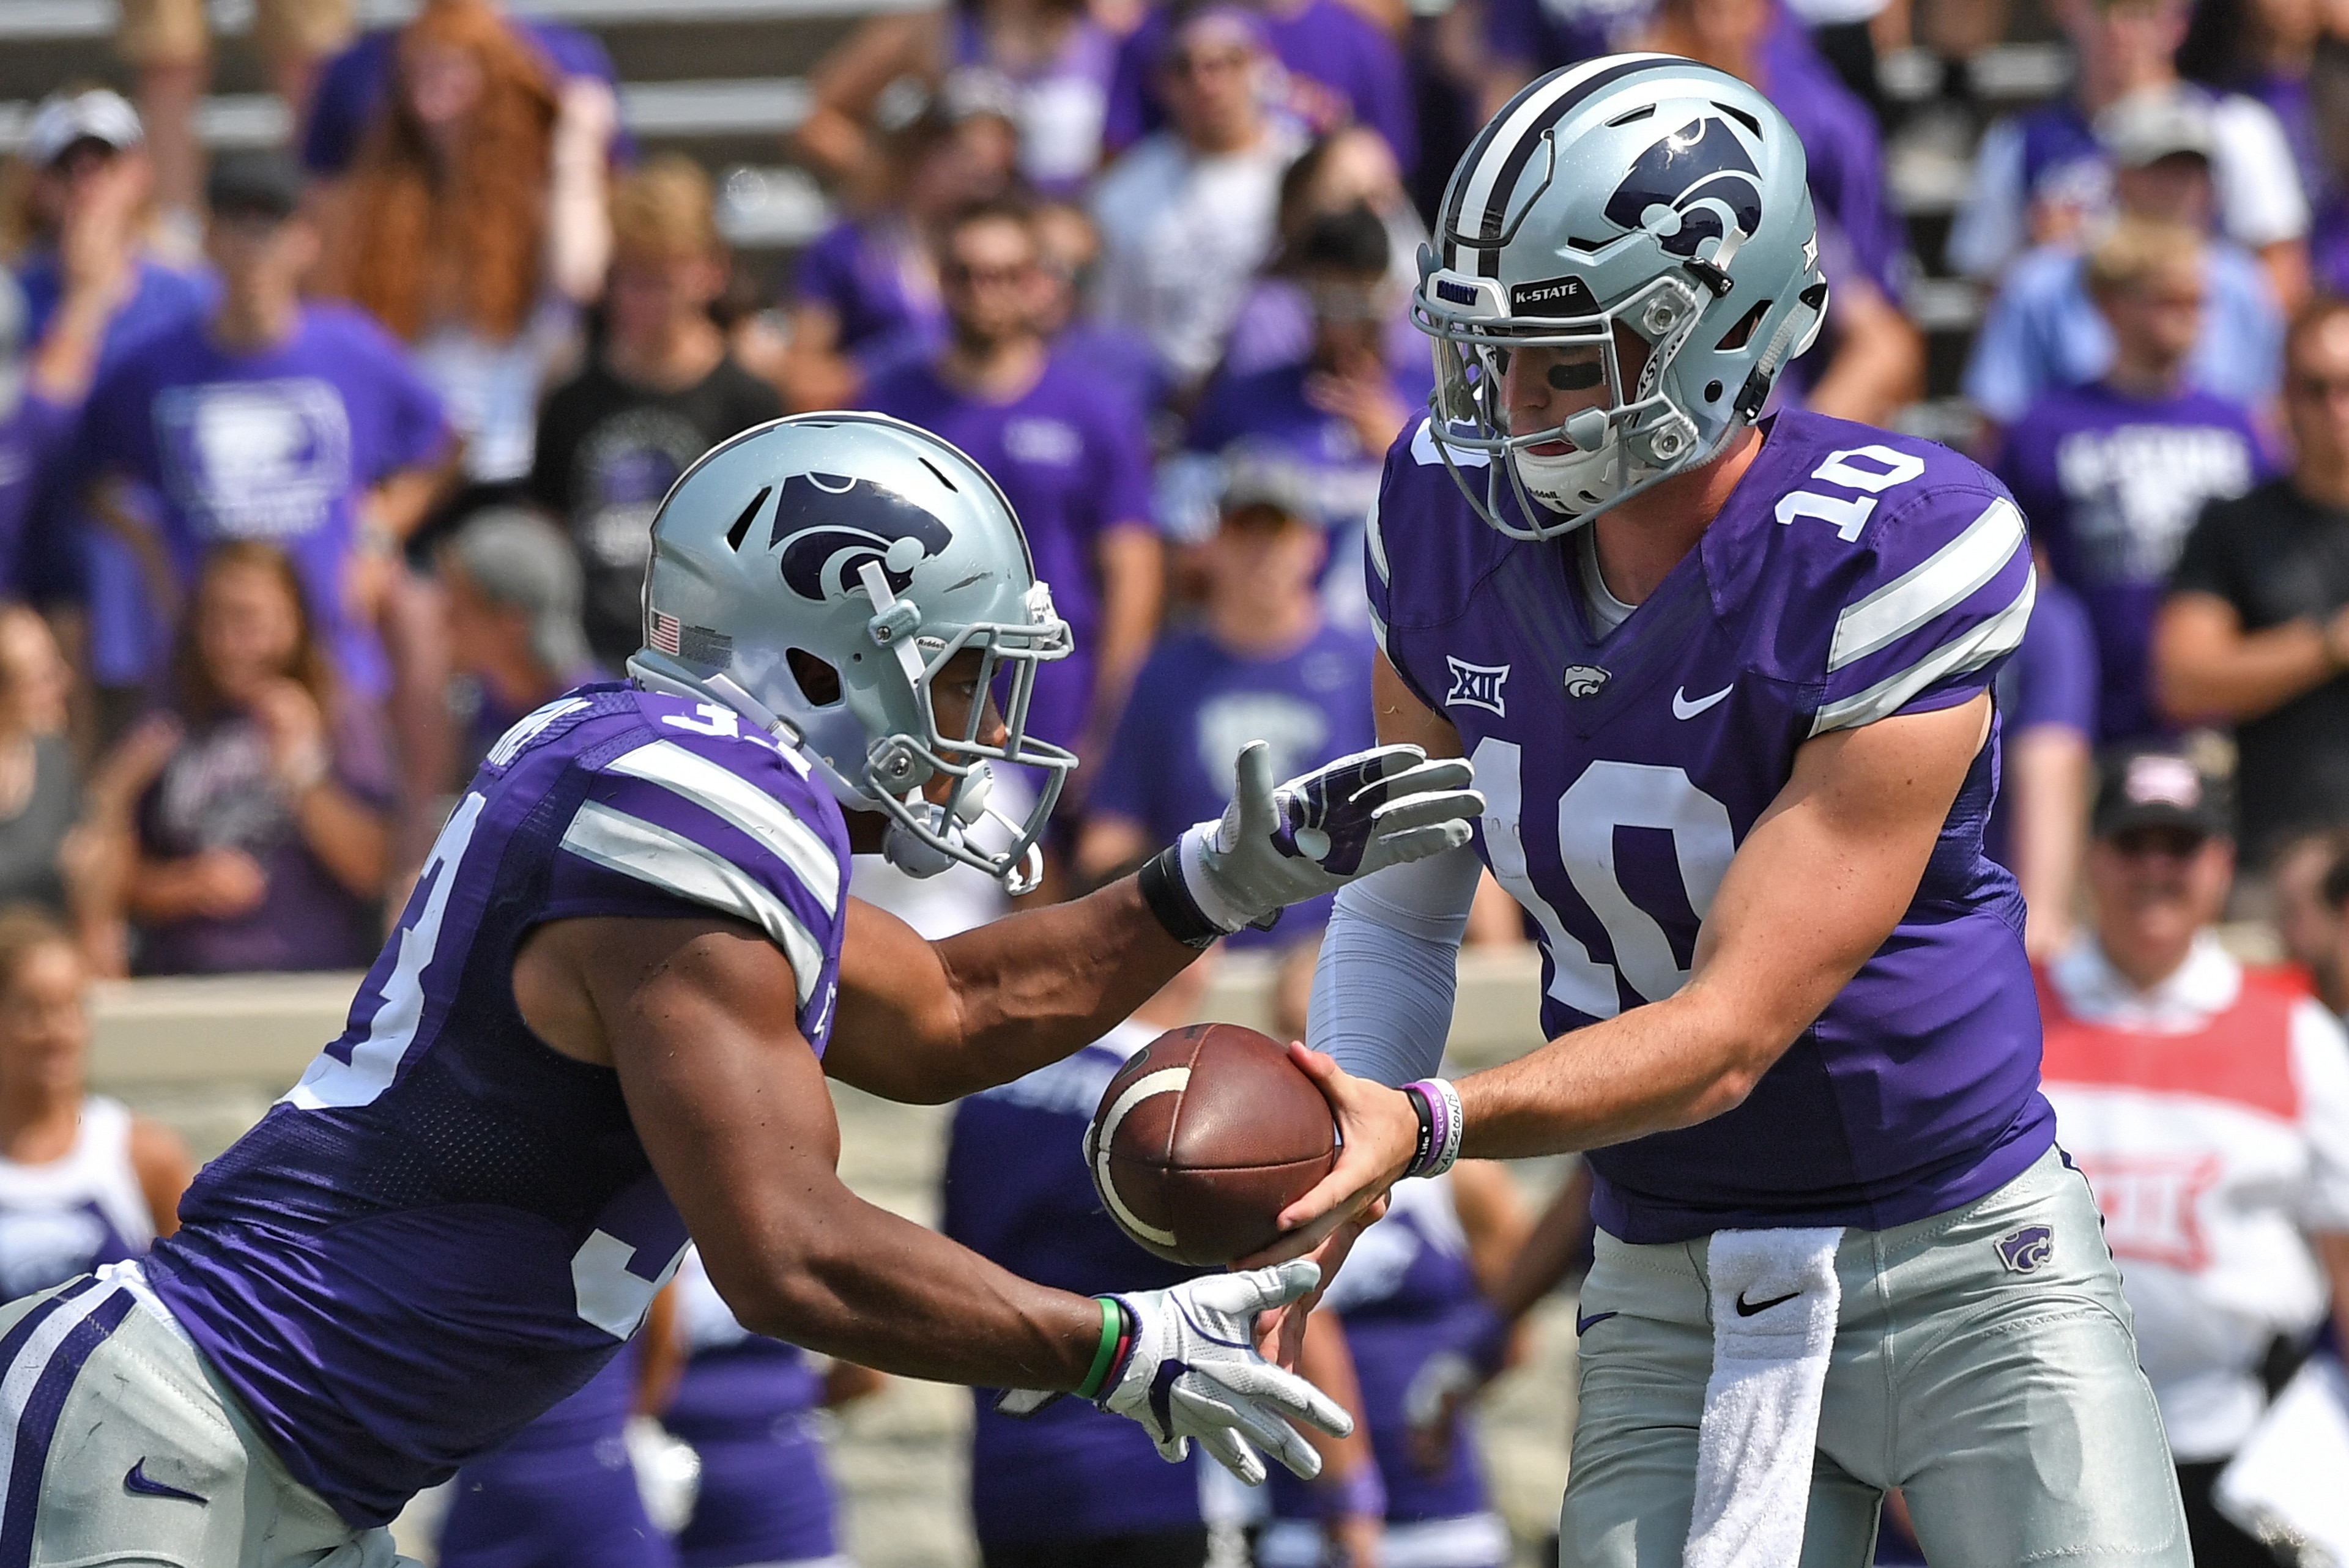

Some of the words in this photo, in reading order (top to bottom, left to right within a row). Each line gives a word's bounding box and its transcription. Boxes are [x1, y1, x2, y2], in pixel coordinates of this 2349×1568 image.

[1516, 283, 1578, 304] K-STATE
[1775, 445, 1924, 543] 10
[1469, 736, 1736, 1021] 10
[1419, 1136, 1430, 1156] Life
[1449, 1093, 1461, 1147] SECOND
